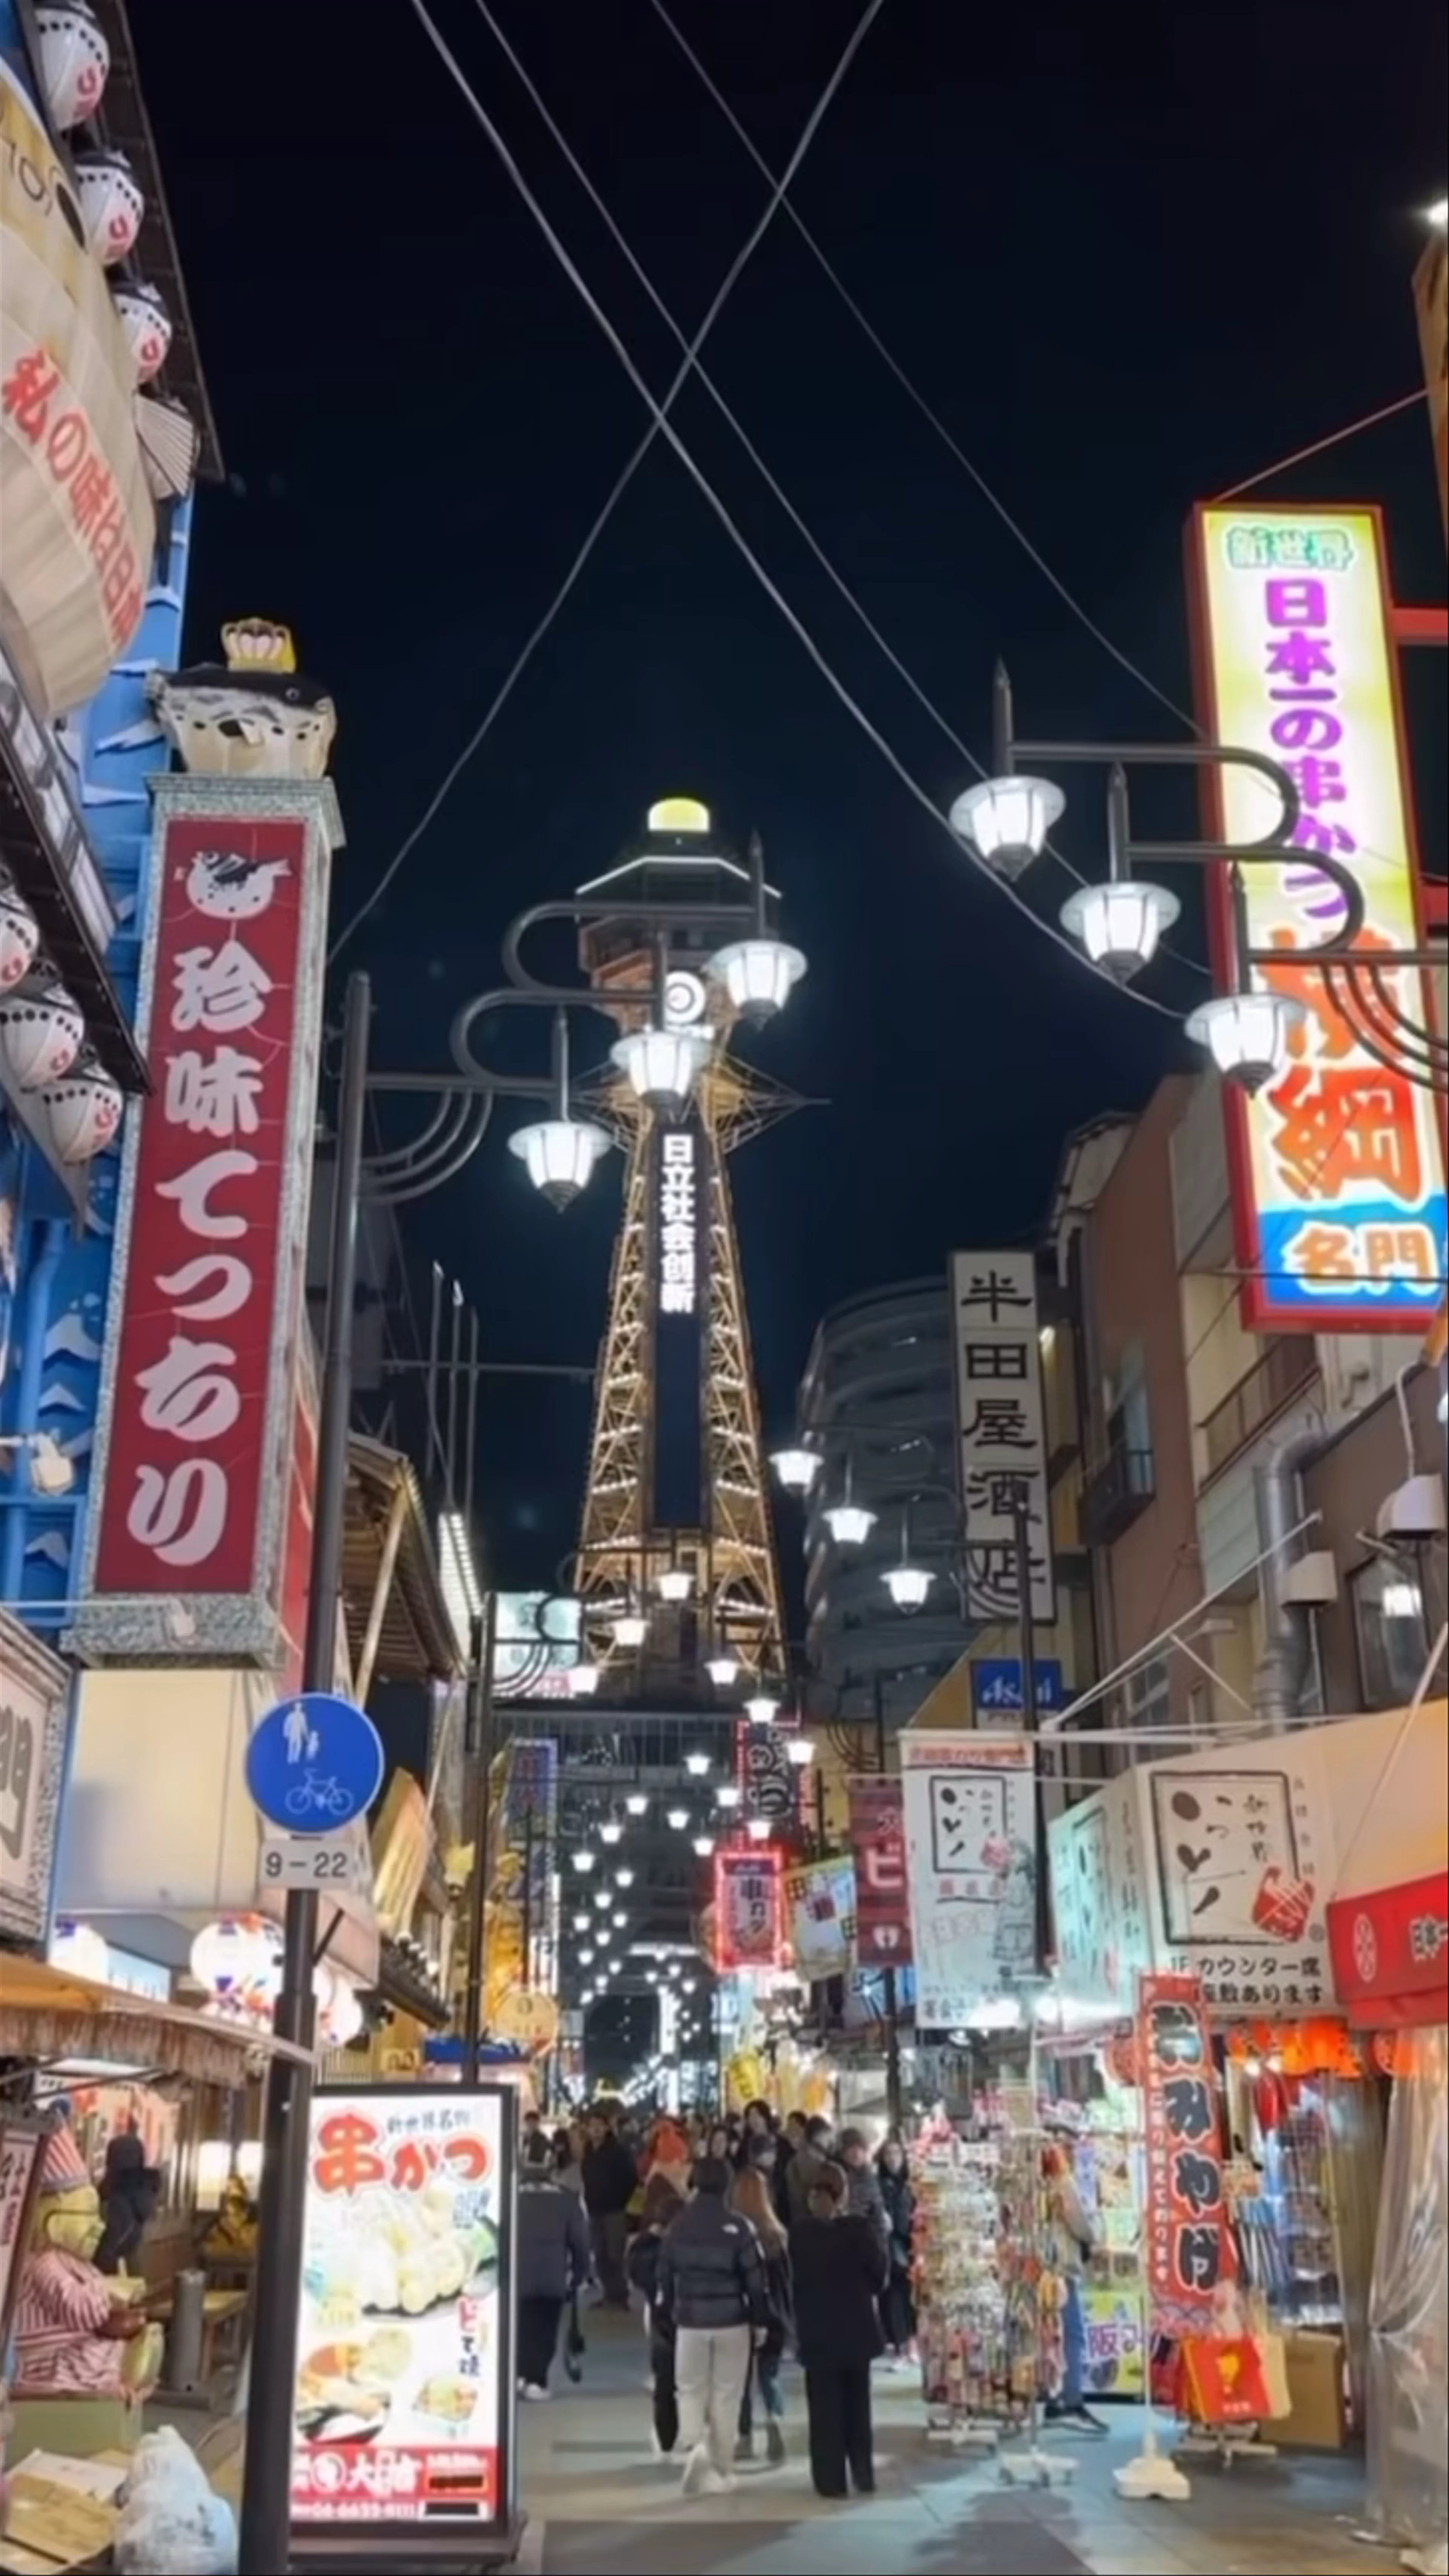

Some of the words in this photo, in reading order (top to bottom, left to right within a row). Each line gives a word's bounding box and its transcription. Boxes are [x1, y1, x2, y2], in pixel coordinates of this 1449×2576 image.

[961, 1270, 1046, 1597] 半田屋酒店
[1198, 1955, 1321, 1977] カウンター席
[313, 2113, 488, 2198] 串かつ
